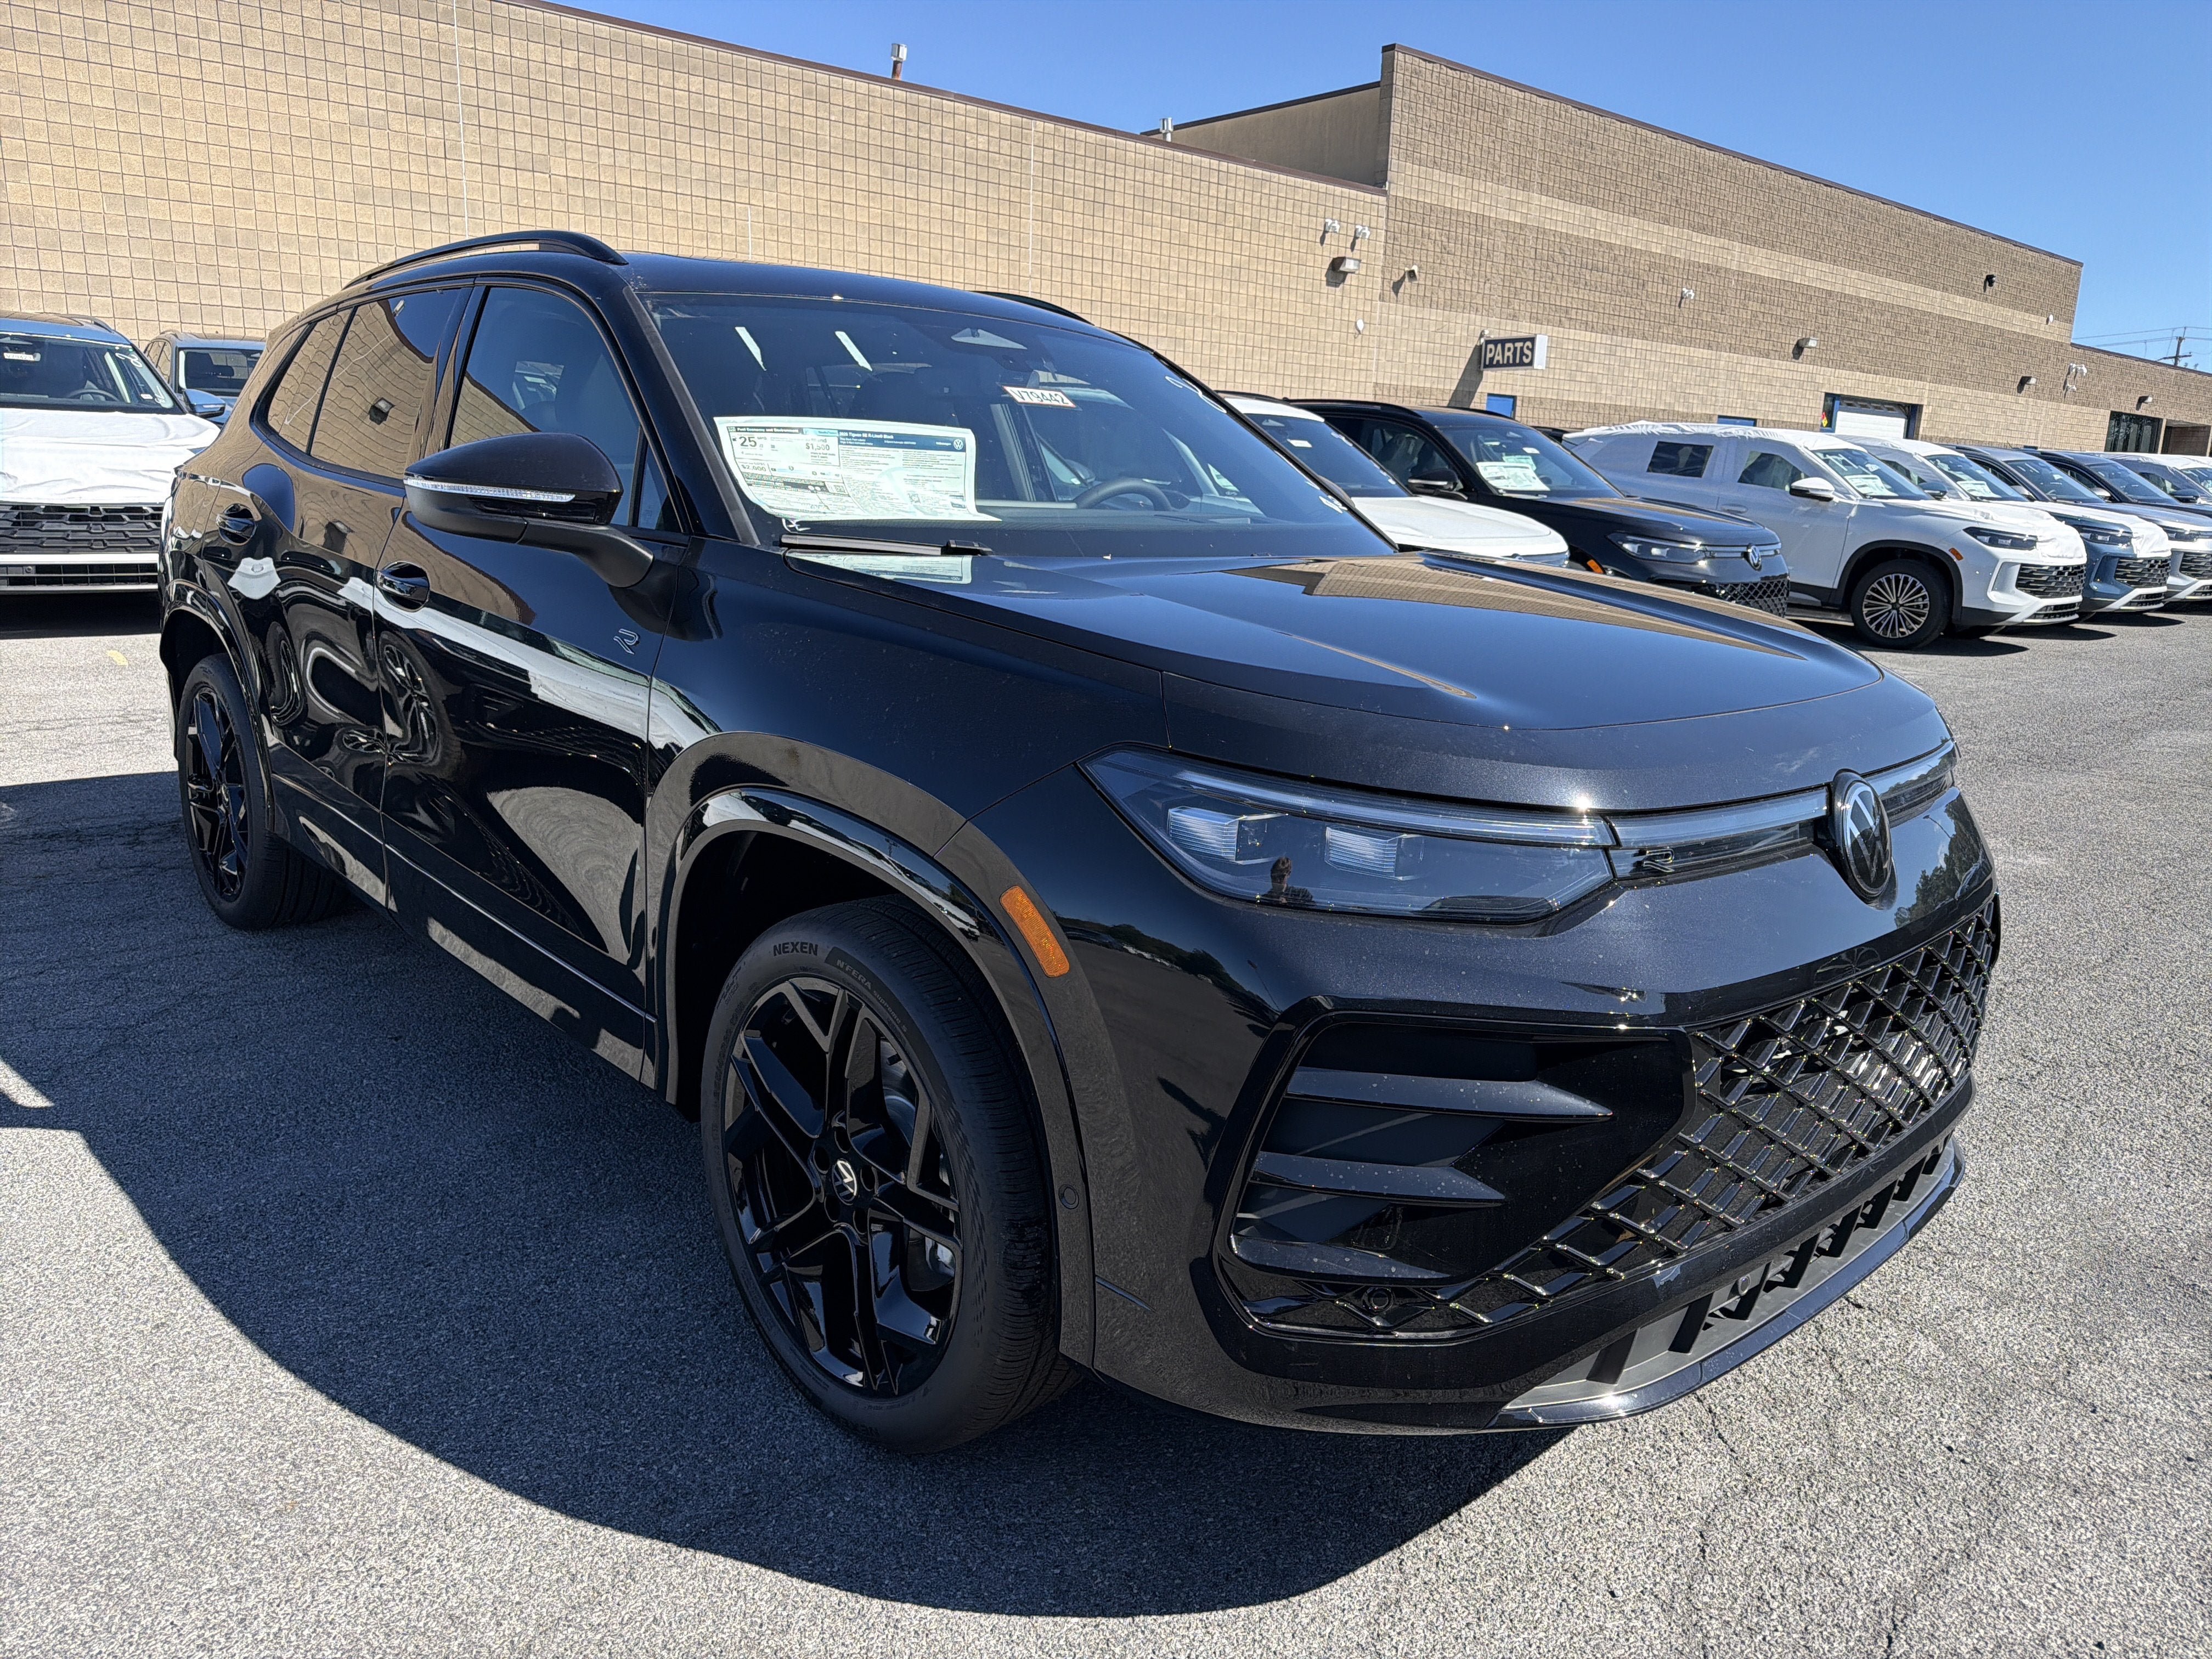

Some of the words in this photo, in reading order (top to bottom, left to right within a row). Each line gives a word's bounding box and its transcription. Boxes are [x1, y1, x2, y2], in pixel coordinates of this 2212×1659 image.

[1486, 341, 1532, 365] PARTS
[1010, 389, 1069, 404] V79442
[739, 437, 757, 447] 25
[806, 443, 830, 451] $1,500
[773, 941, 819, 956] NEXEN
[837, 960, 872, 990] N'FERA
